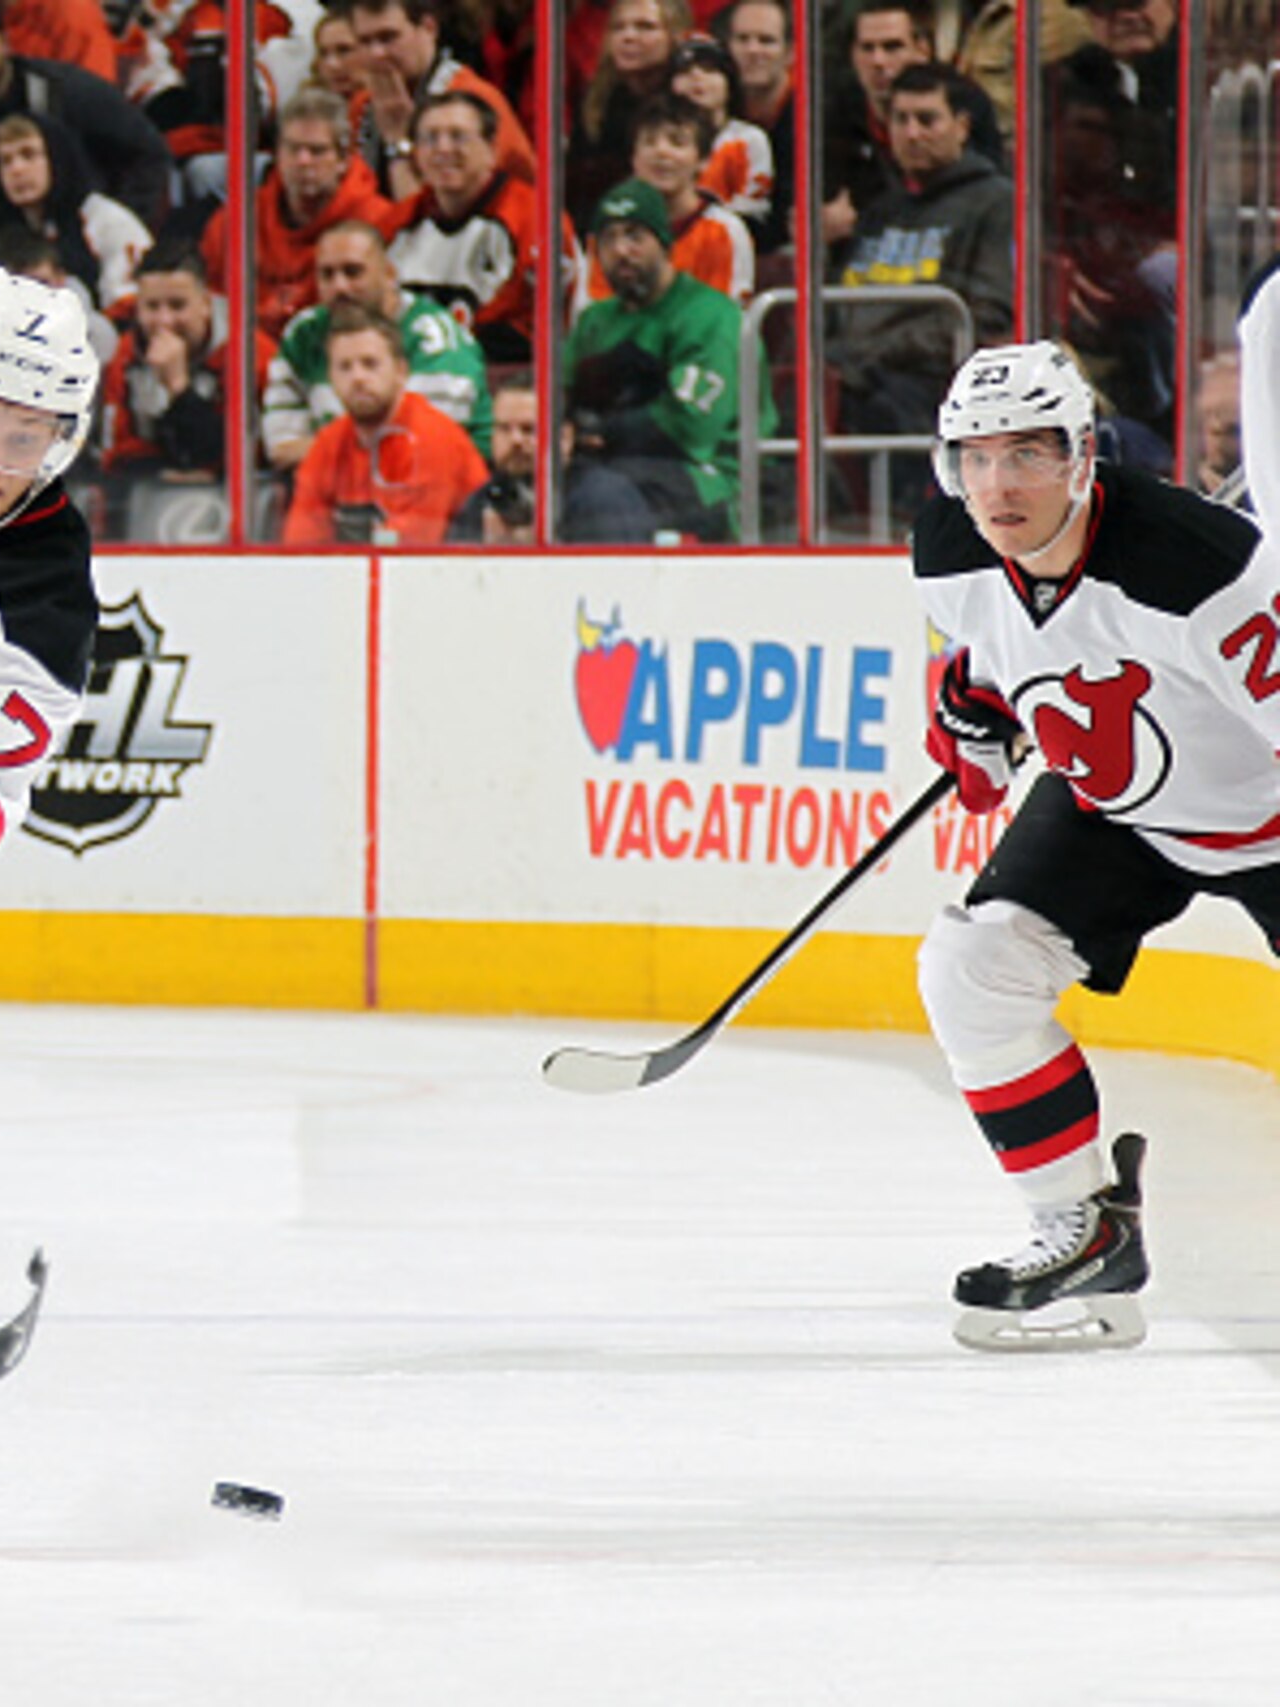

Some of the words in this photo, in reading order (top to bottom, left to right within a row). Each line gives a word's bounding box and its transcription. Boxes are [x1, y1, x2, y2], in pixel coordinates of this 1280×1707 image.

[674, 364, 724, 413] 17
[1220, 592, 1280, 702] 2
[614, 637, 892, 772] APPLE
[584, 778, 894, 875] VACATIONS
